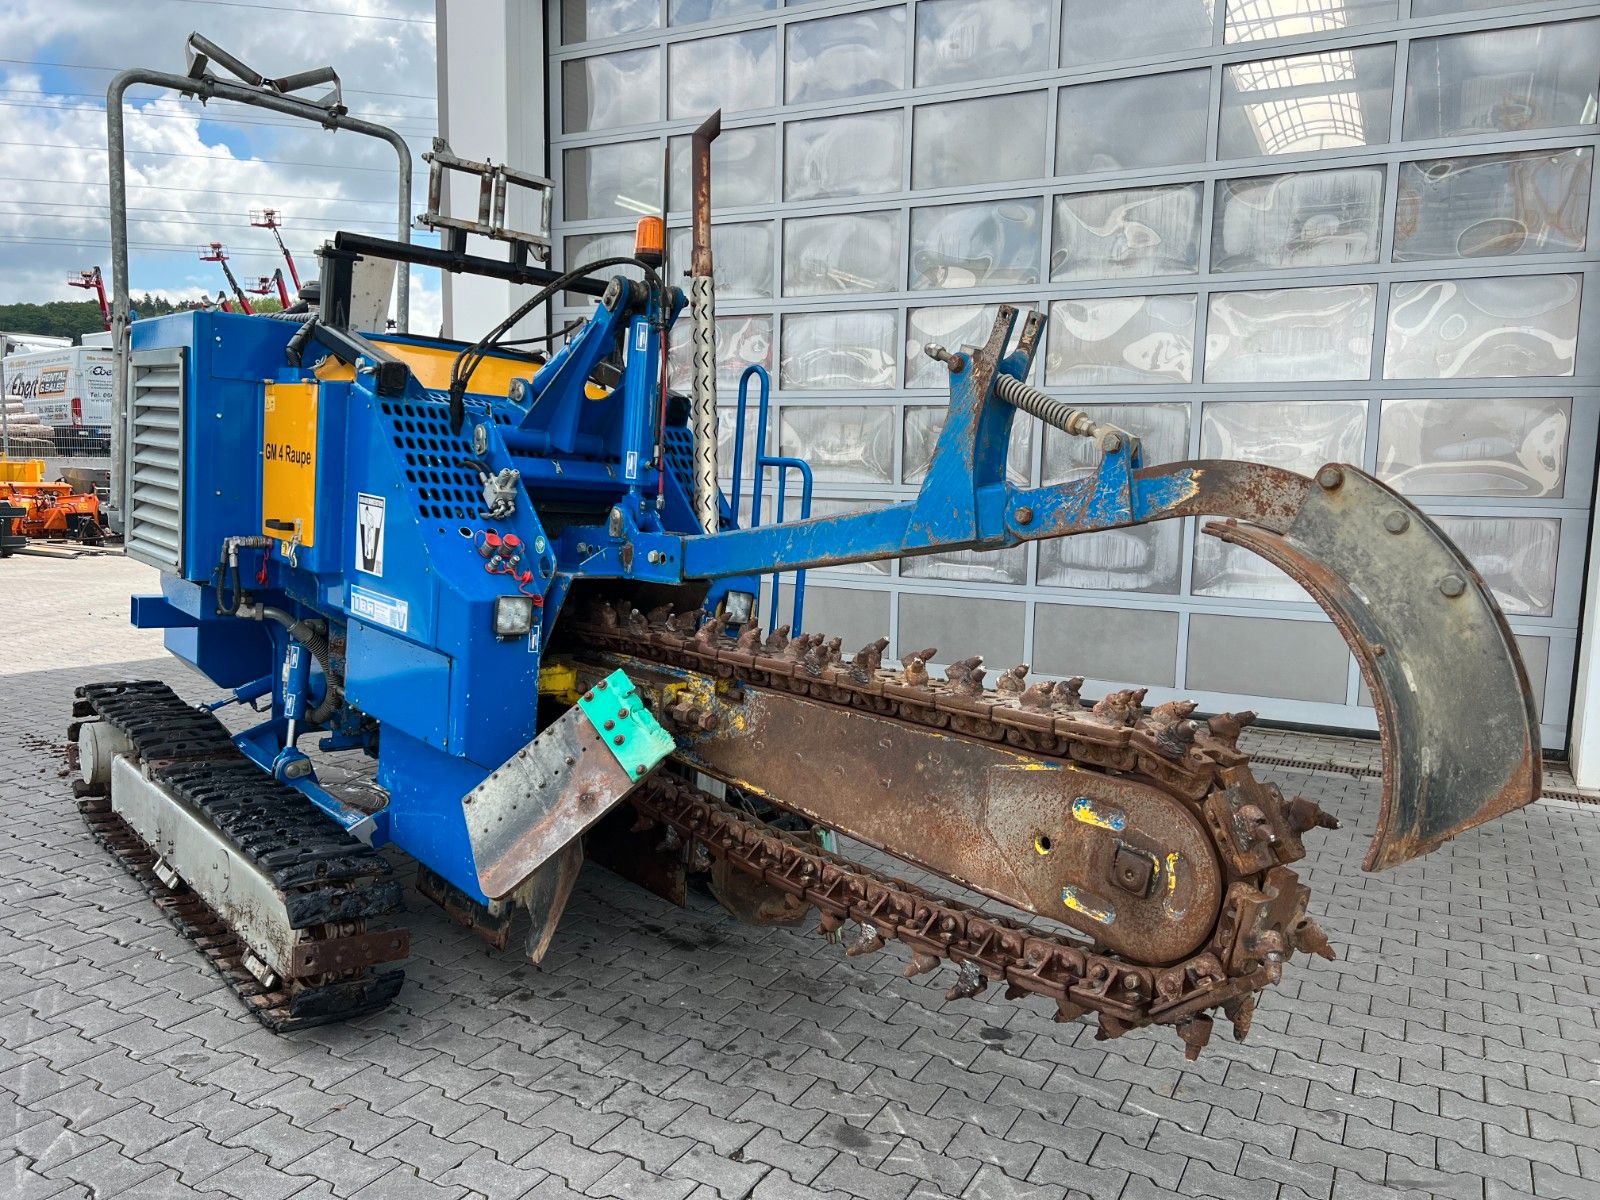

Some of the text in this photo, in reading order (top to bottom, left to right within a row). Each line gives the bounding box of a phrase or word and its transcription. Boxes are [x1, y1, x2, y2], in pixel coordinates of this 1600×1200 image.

[12, 373, 39, 398] Ebert
[42, 371, 66, 382] RENTAL
[266, 443, 311, 468] GM 4 Raupe
